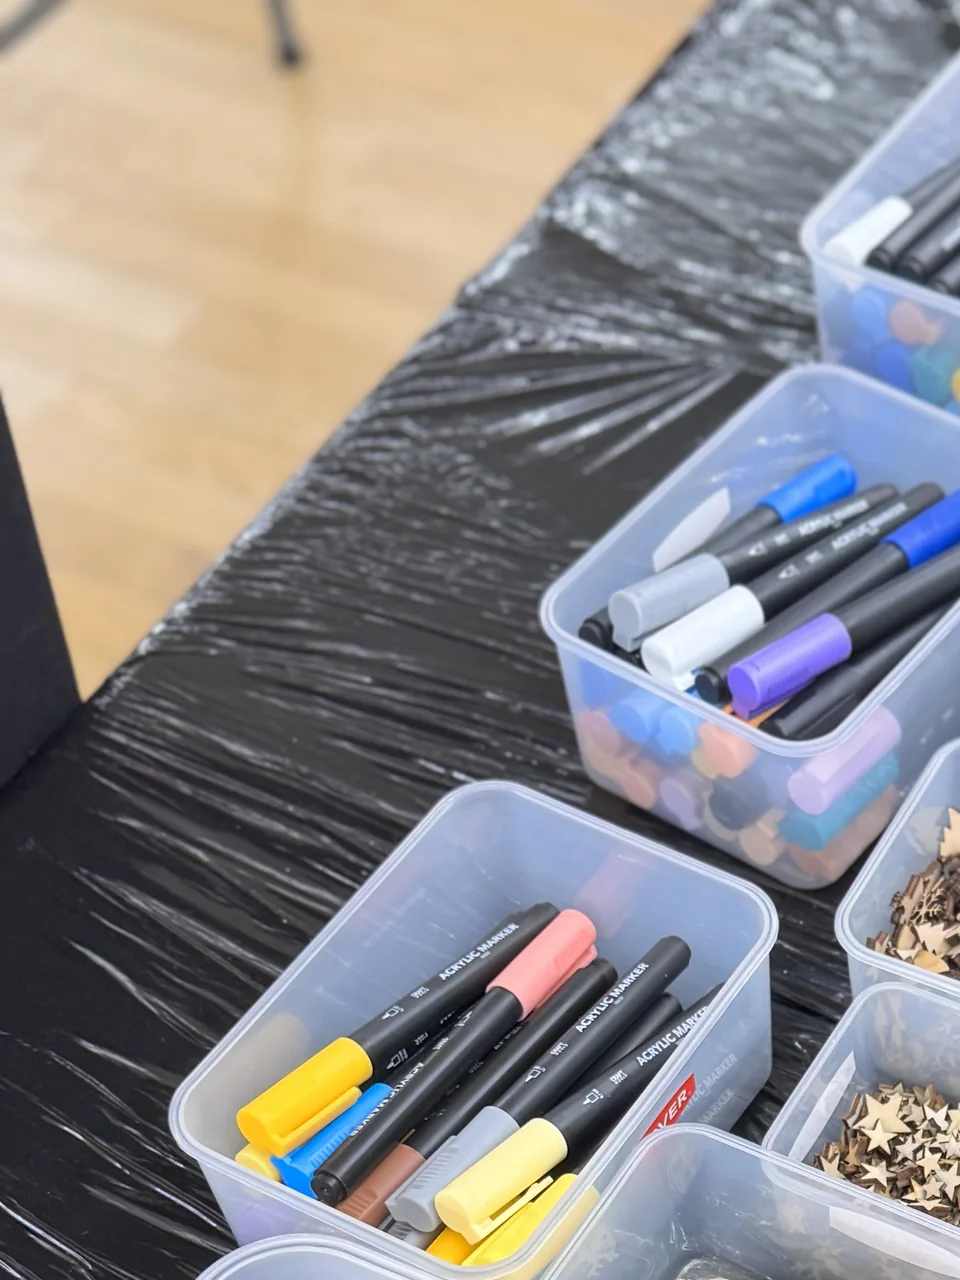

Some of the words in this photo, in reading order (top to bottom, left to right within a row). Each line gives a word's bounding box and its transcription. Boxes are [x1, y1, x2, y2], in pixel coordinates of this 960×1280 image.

[439, 949, 481, 981] ACRYLIC
[477, 922, 519, 953] MARKER
[575, 996, 614, 1033] ACRYLIC
[609, 962, 649, 1000] MARKER
[636, 1033, 677, 1067] ACRYLIC
[653, 1089, 687, 1132] VER
